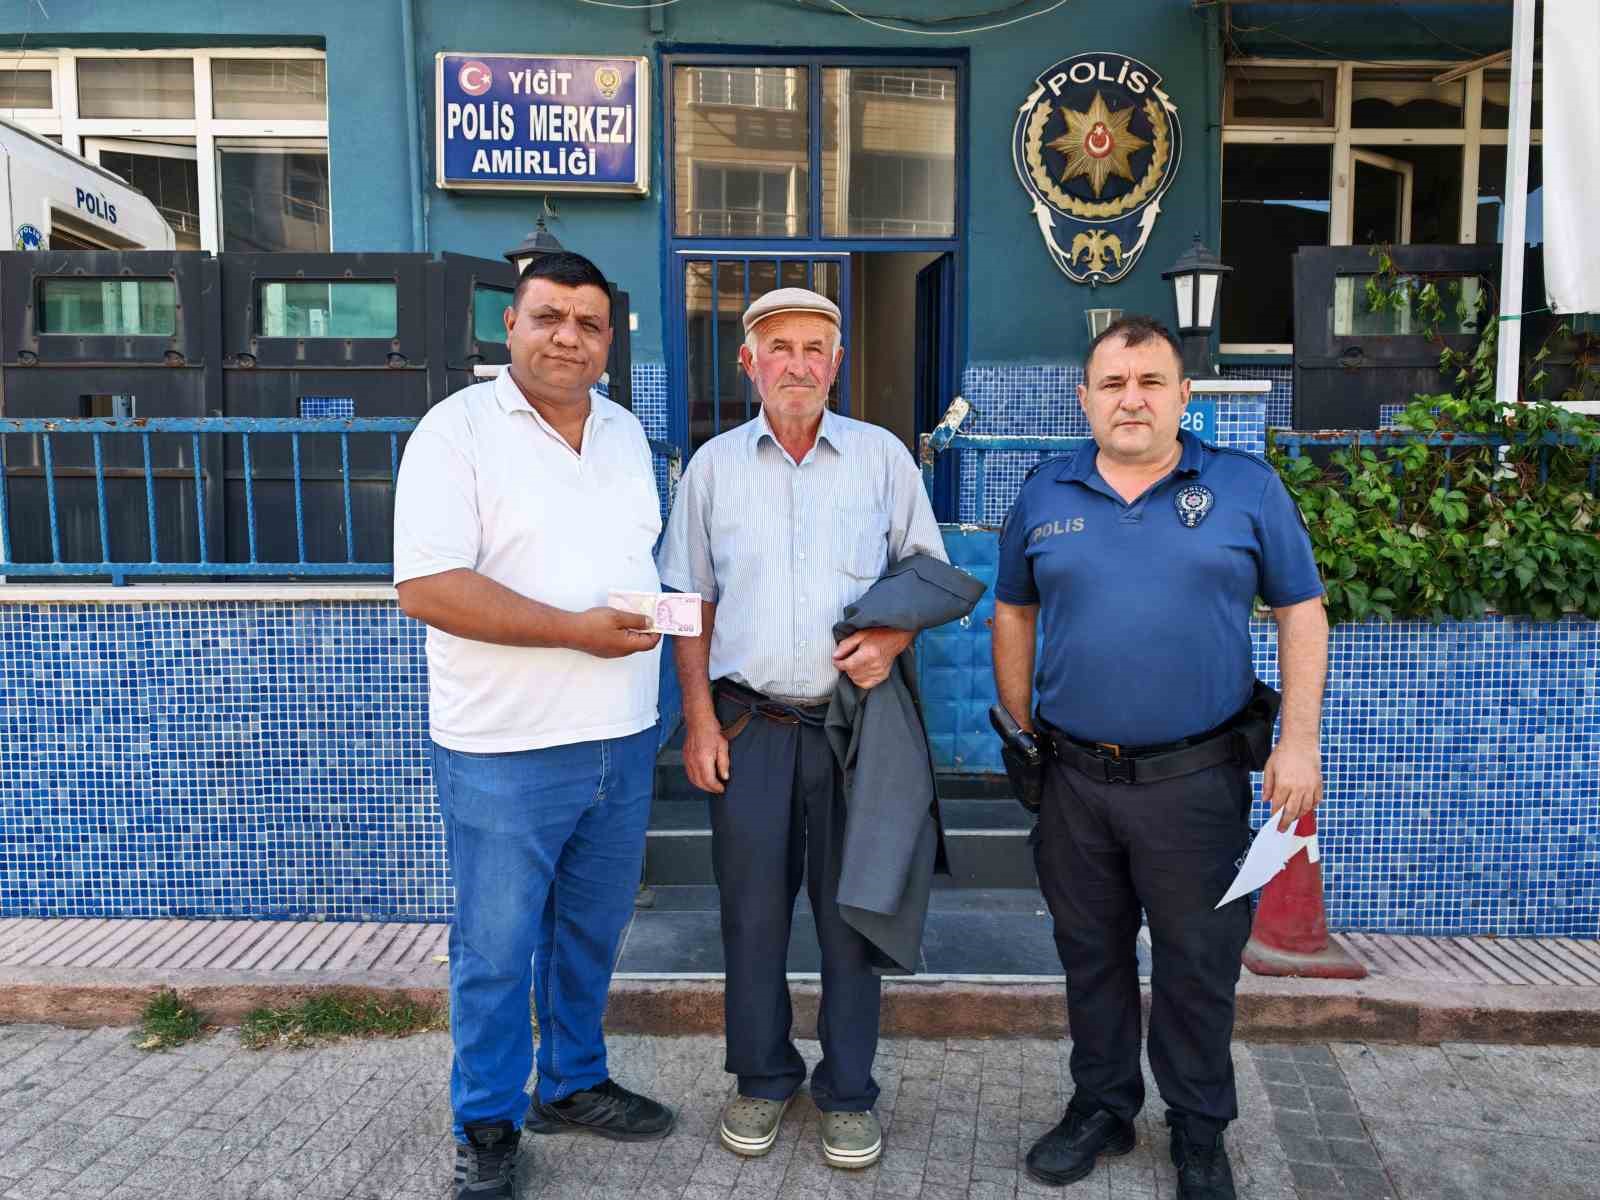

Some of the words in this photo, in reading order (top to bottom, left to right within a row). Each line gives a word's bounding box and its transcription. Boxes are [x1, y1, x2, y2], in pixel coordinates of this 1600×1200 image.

[508, 69, 573, 95] YİĞİT
[1047, 60, 1149, 96] POLİS
[447, 101, 515, 140] POLİS
[529, 104, 632, 144] MERKEZİ
[472, 146, 597, 175] AMİRLİĞİ
